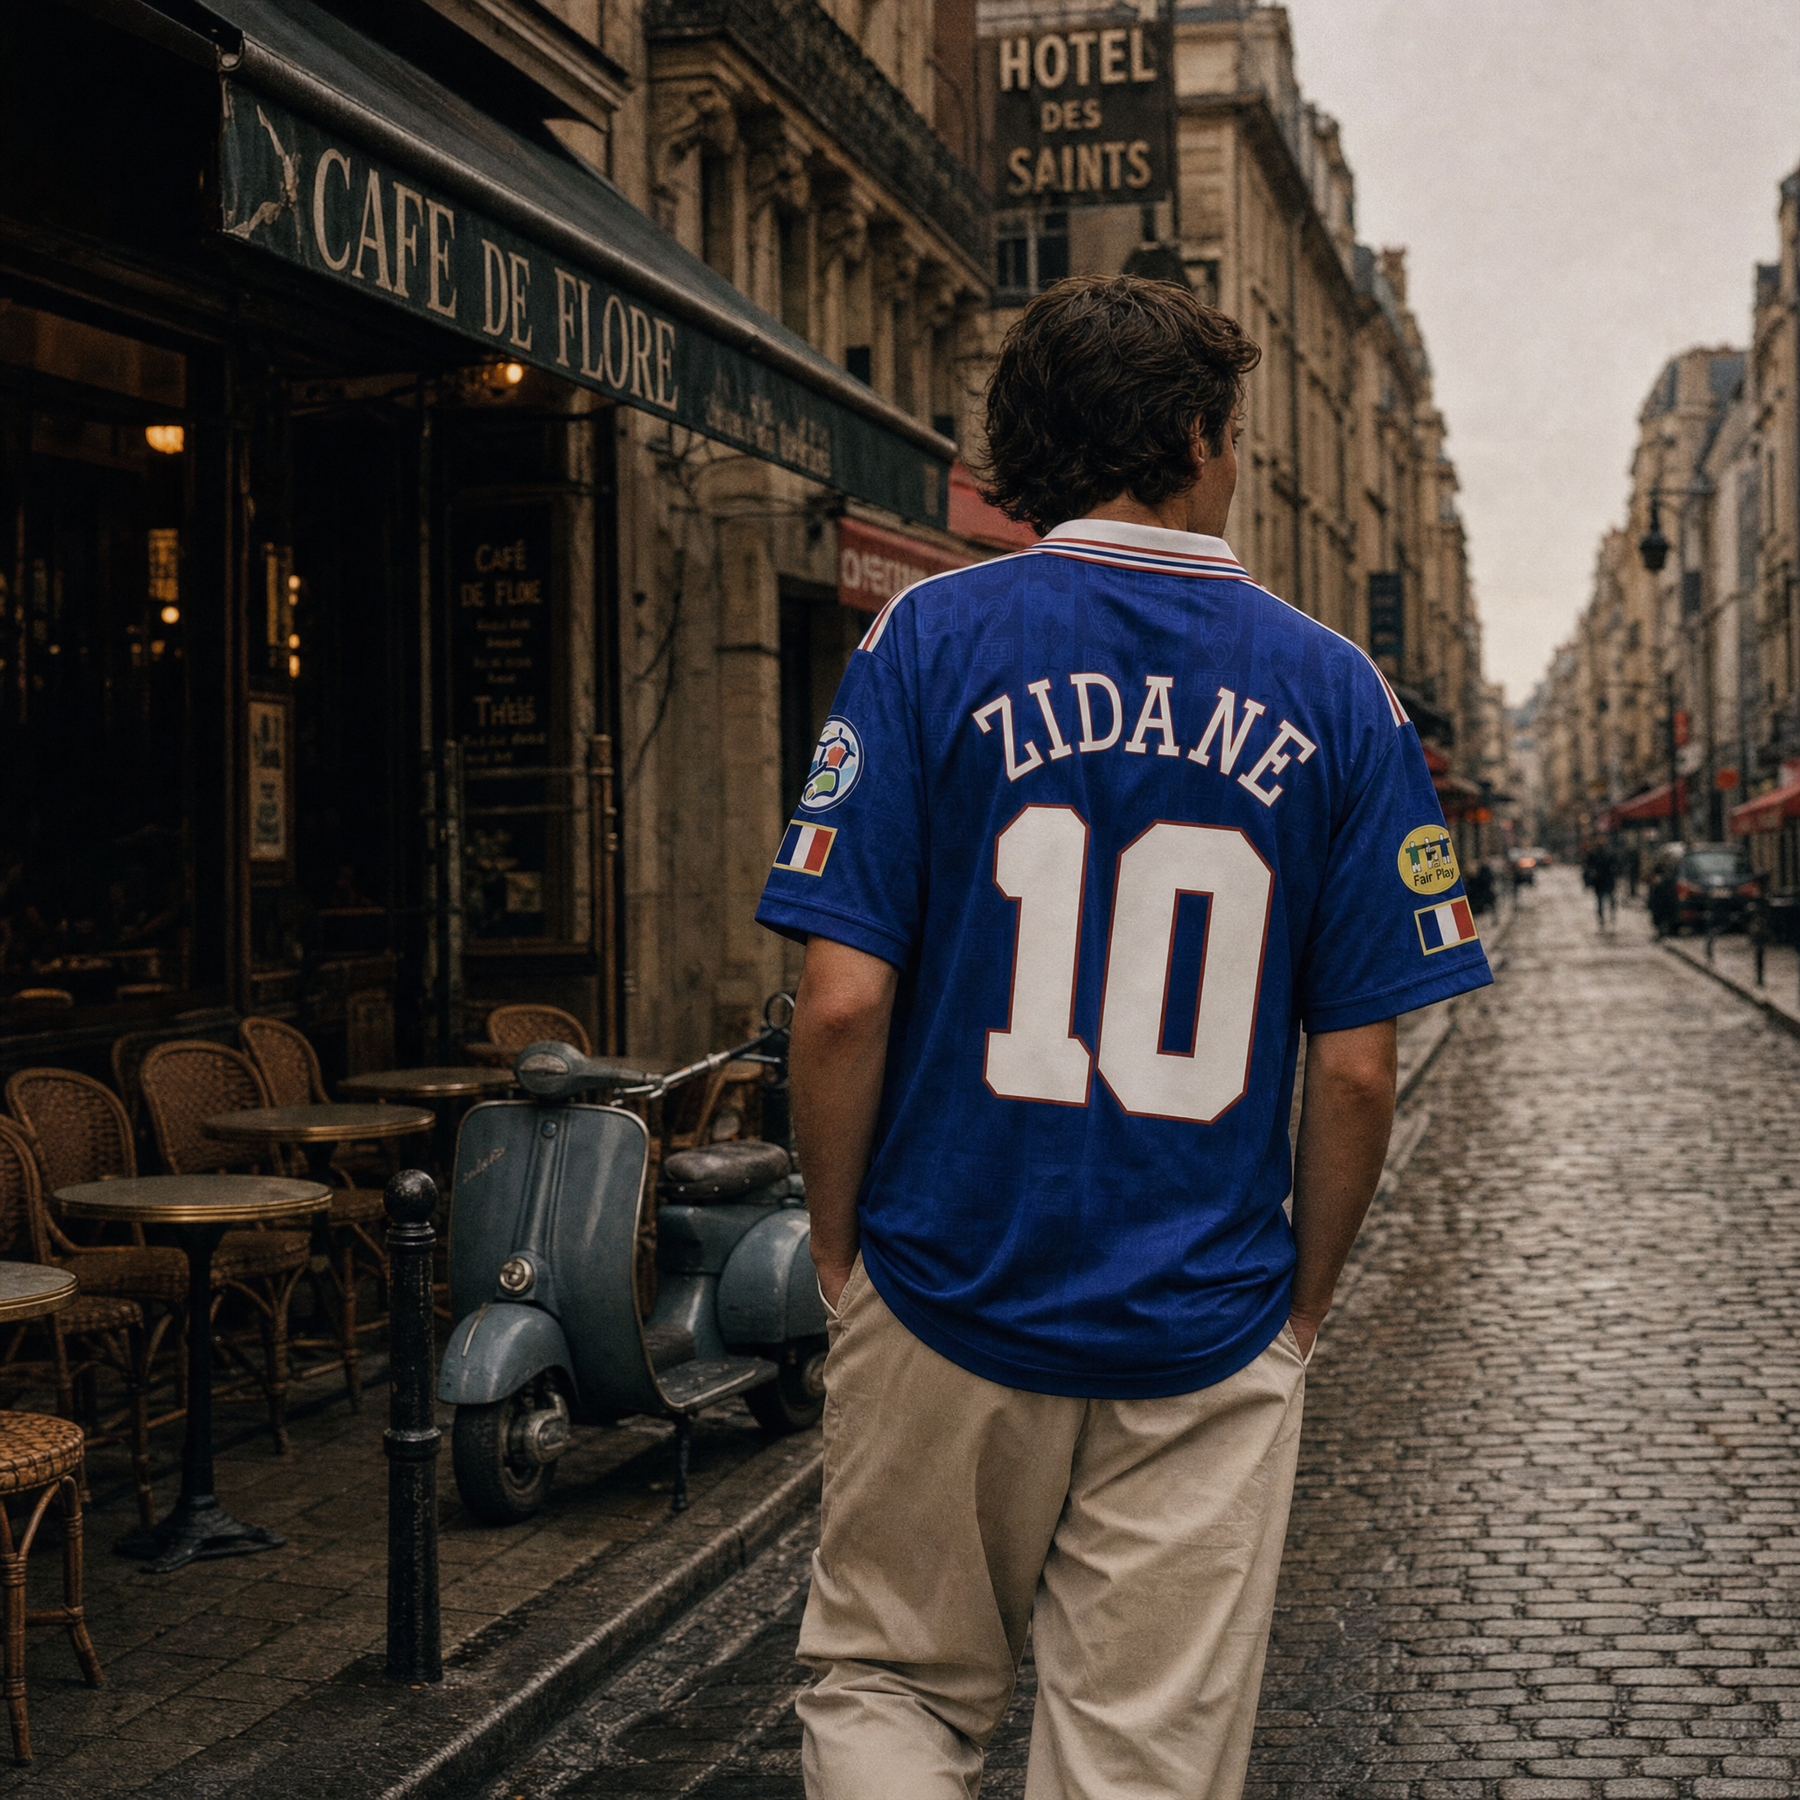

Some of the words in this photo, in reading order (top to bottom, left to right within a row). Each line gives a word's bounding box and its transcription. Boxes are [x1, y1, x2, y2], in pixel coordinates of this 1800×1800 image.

[1000, 28, 1157, 92] HOTEL
[1040, 98, 1102, 133] DES
[1007, 139, 1152, 196] SAINTS
[313, 148, 457, 319] CAFE
[482, 238, 533, 352] DE
[554, 266, 679, 412] FLORE
[460, 582, 486, 608] DE
[972, 672, 1317, 808] ZIDANE
[1413, 872, 1433, 886] Fair
[1436, 868, 1454, 880] Play
[982, 802, 1276, 1126] 10
